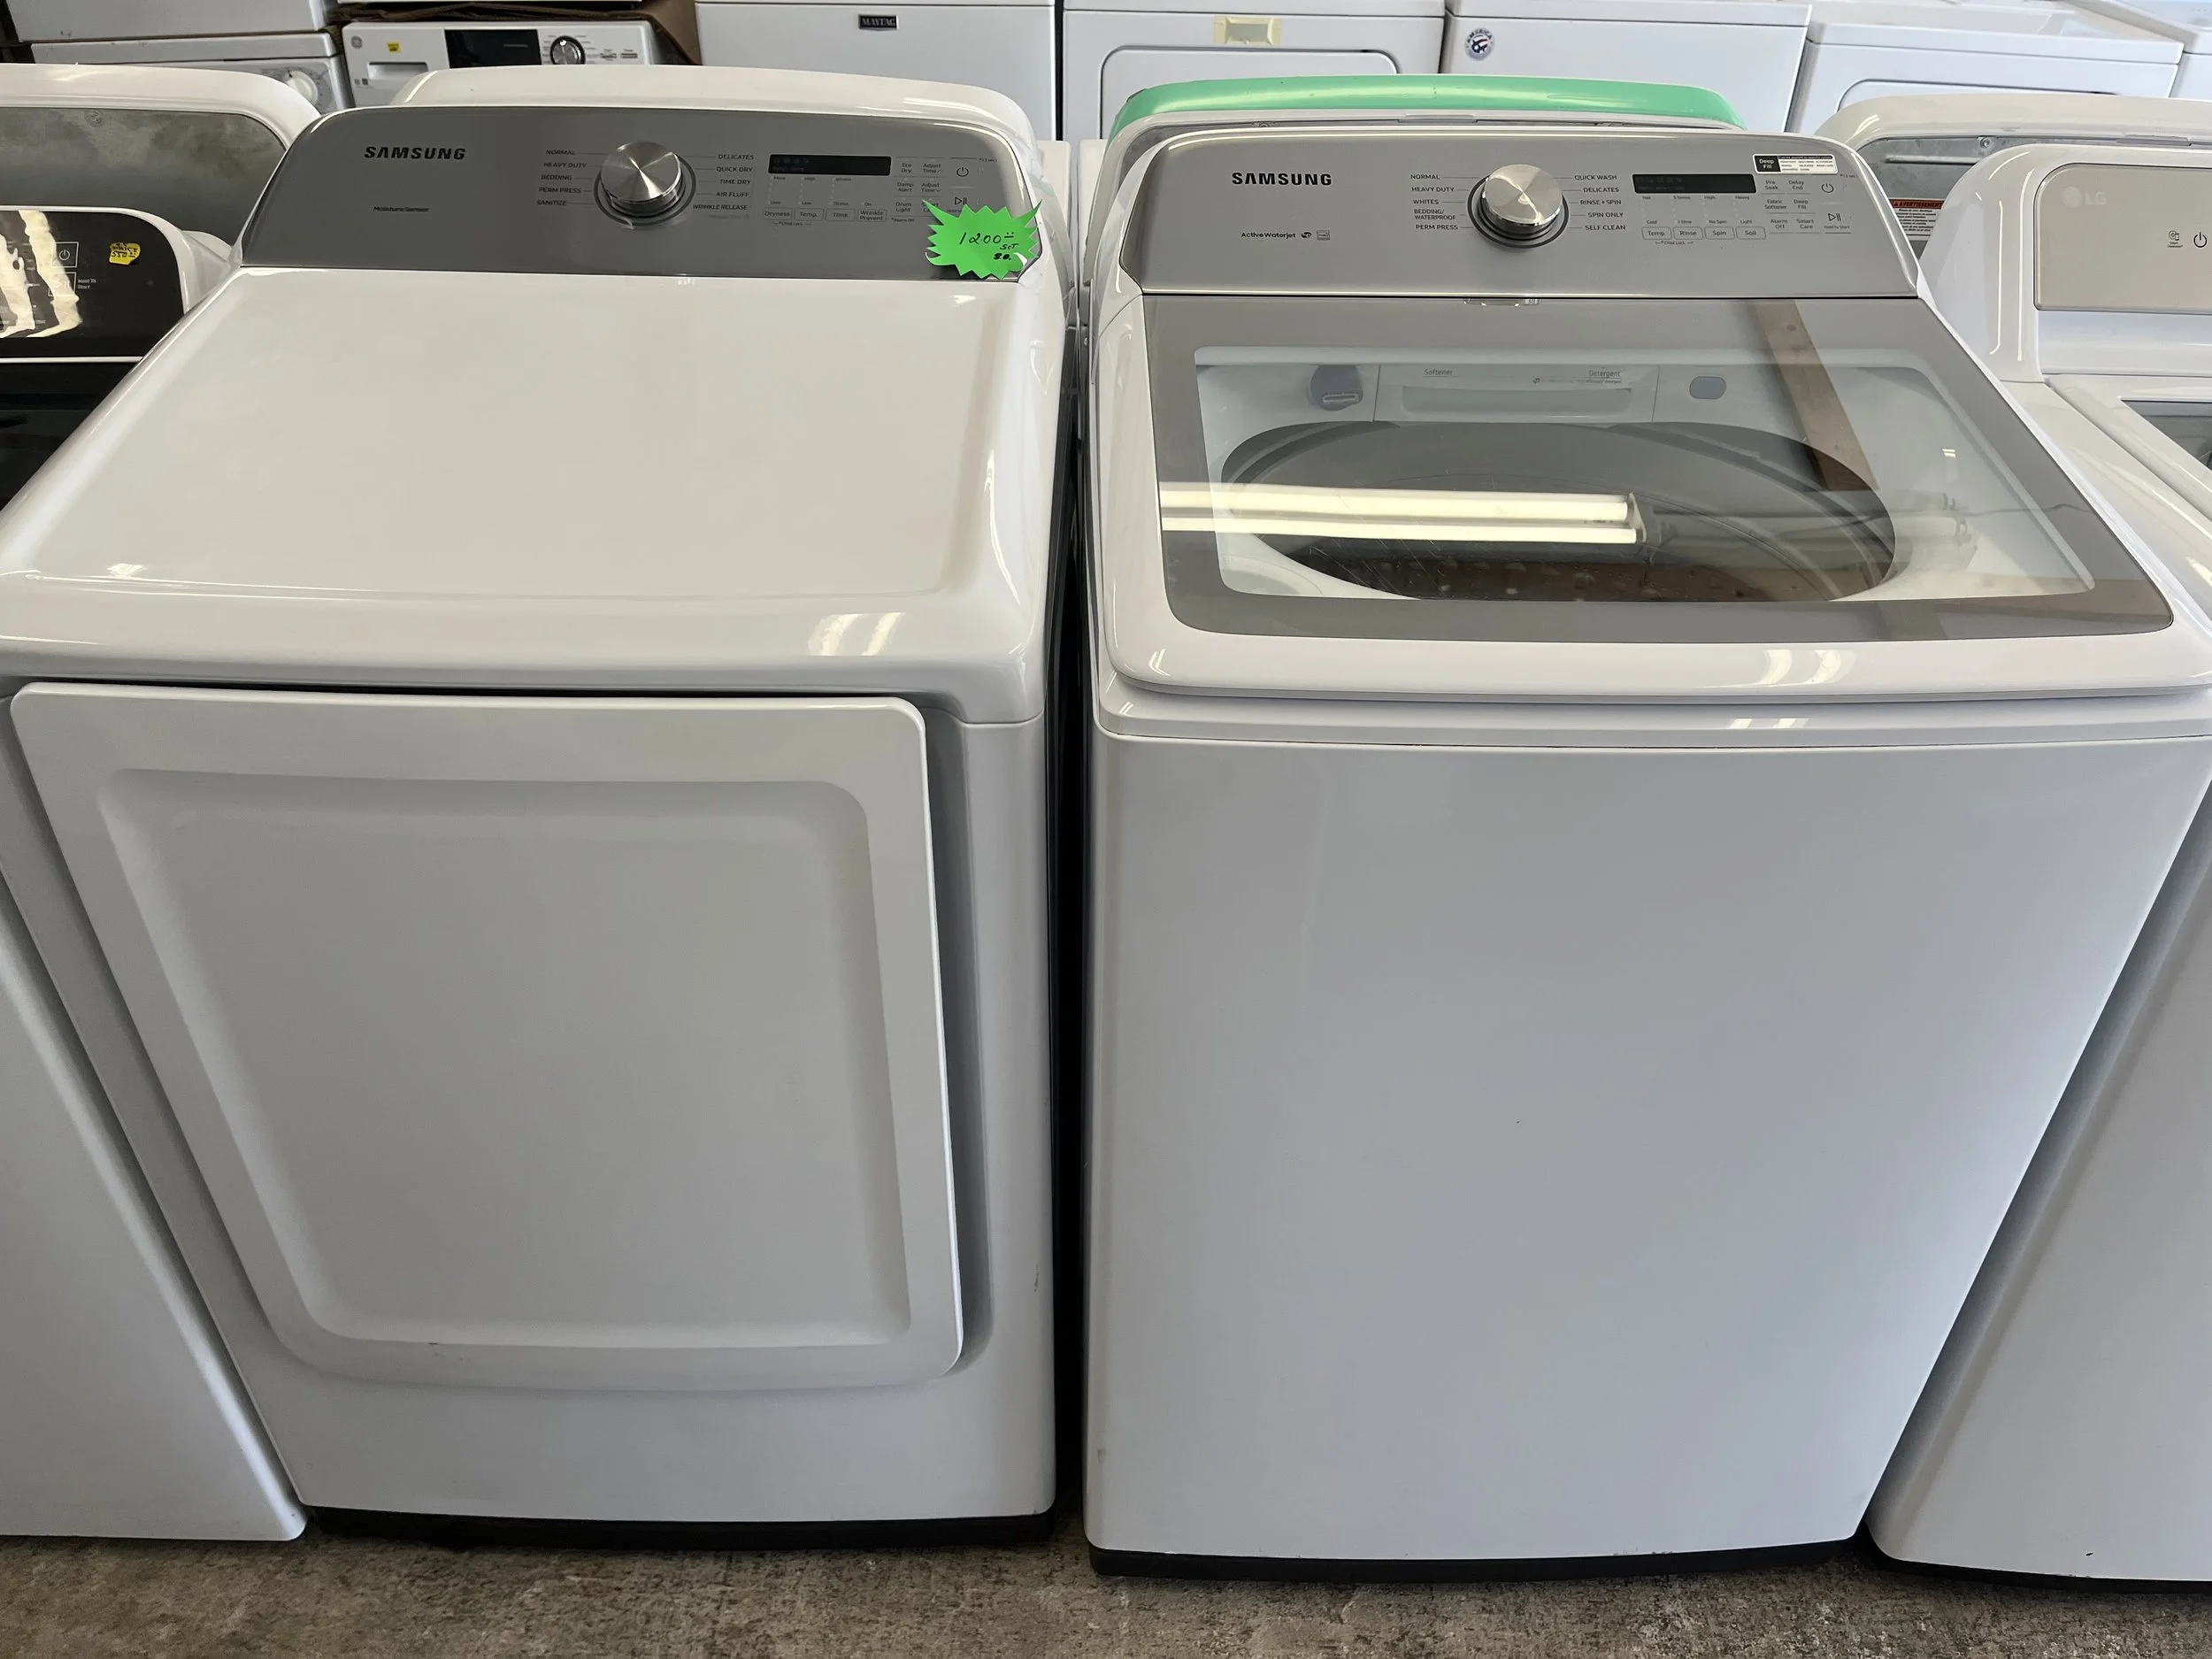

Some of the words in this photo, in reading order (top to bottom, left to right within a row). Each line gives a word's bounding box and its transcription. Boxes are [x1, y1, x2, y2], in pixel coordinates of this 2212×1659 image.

[365, 146, 466, 160] SAMSUNG
[1232, 173, 1332, 186] SAMSUNG
[2085, 191, 2108, 205] LG
[1588, 369, 1622, 379] Detergent
